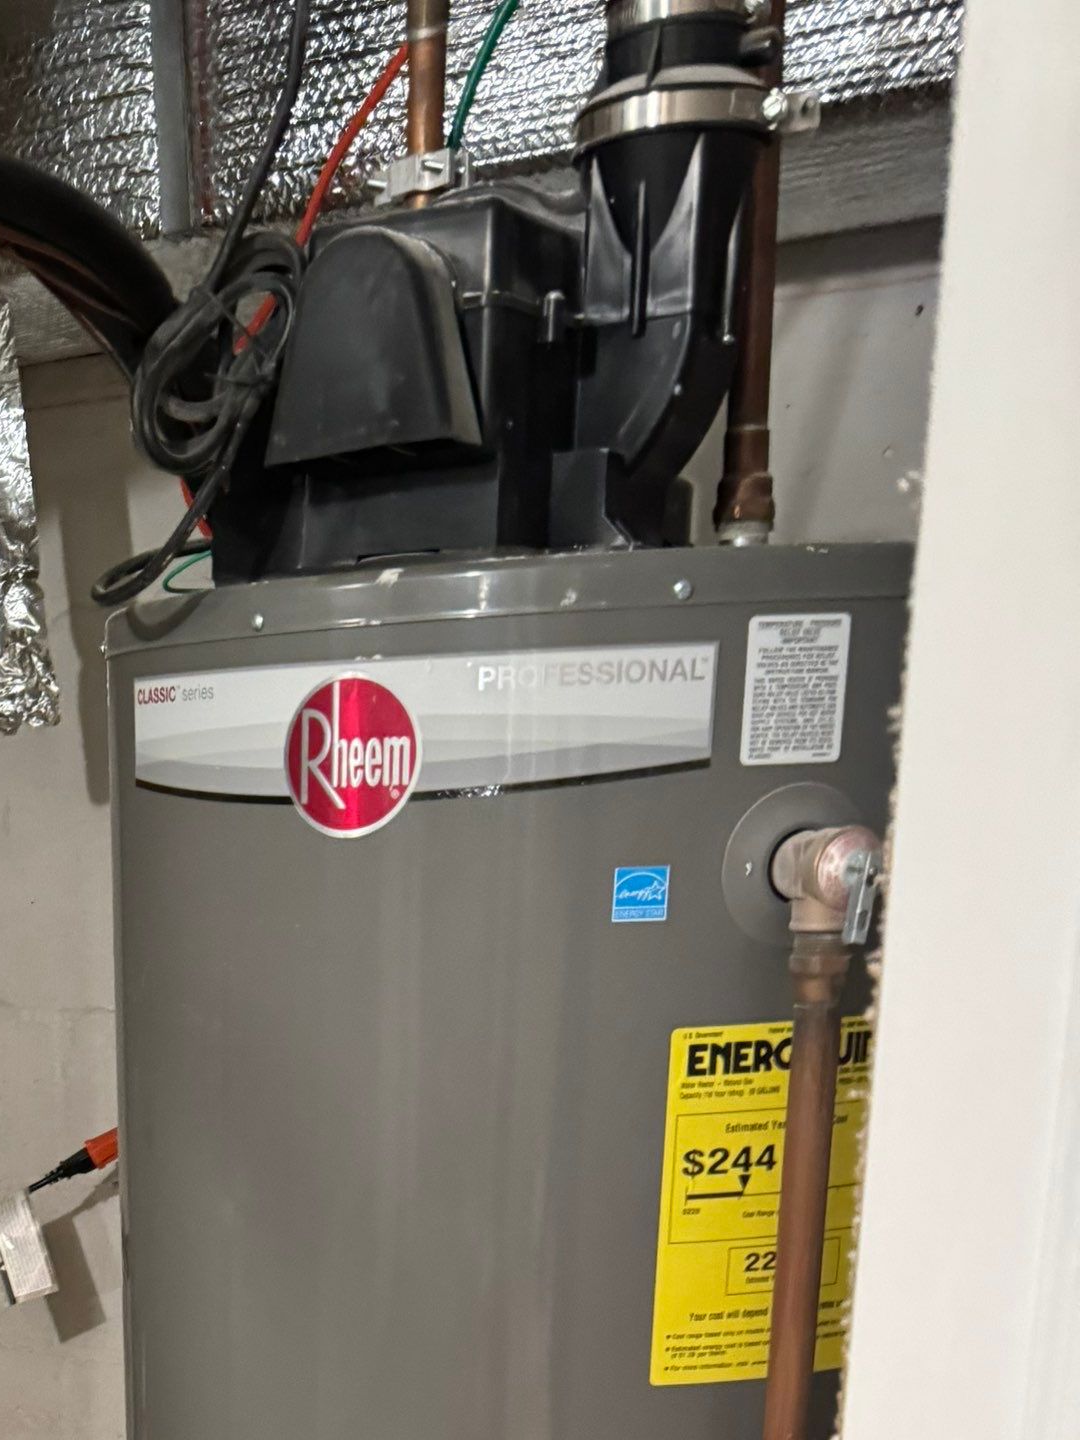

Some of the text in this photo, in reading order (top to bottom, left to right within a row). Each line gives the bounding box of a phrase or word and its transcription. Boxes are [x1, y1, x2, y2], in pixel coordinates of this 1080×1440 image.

[478, 657, 706, 691] PROFESSIONAL
[137, 684, 214, 705] CLASSIC series
[301, 681, 411, 810] Rheem
[687, 1037, 792, 1077] ENERG
[725, 1119, 768, 1133] Estimated
[682, 1144, 777, 1178] $244
[744, 1252, 777, 1272] 22
